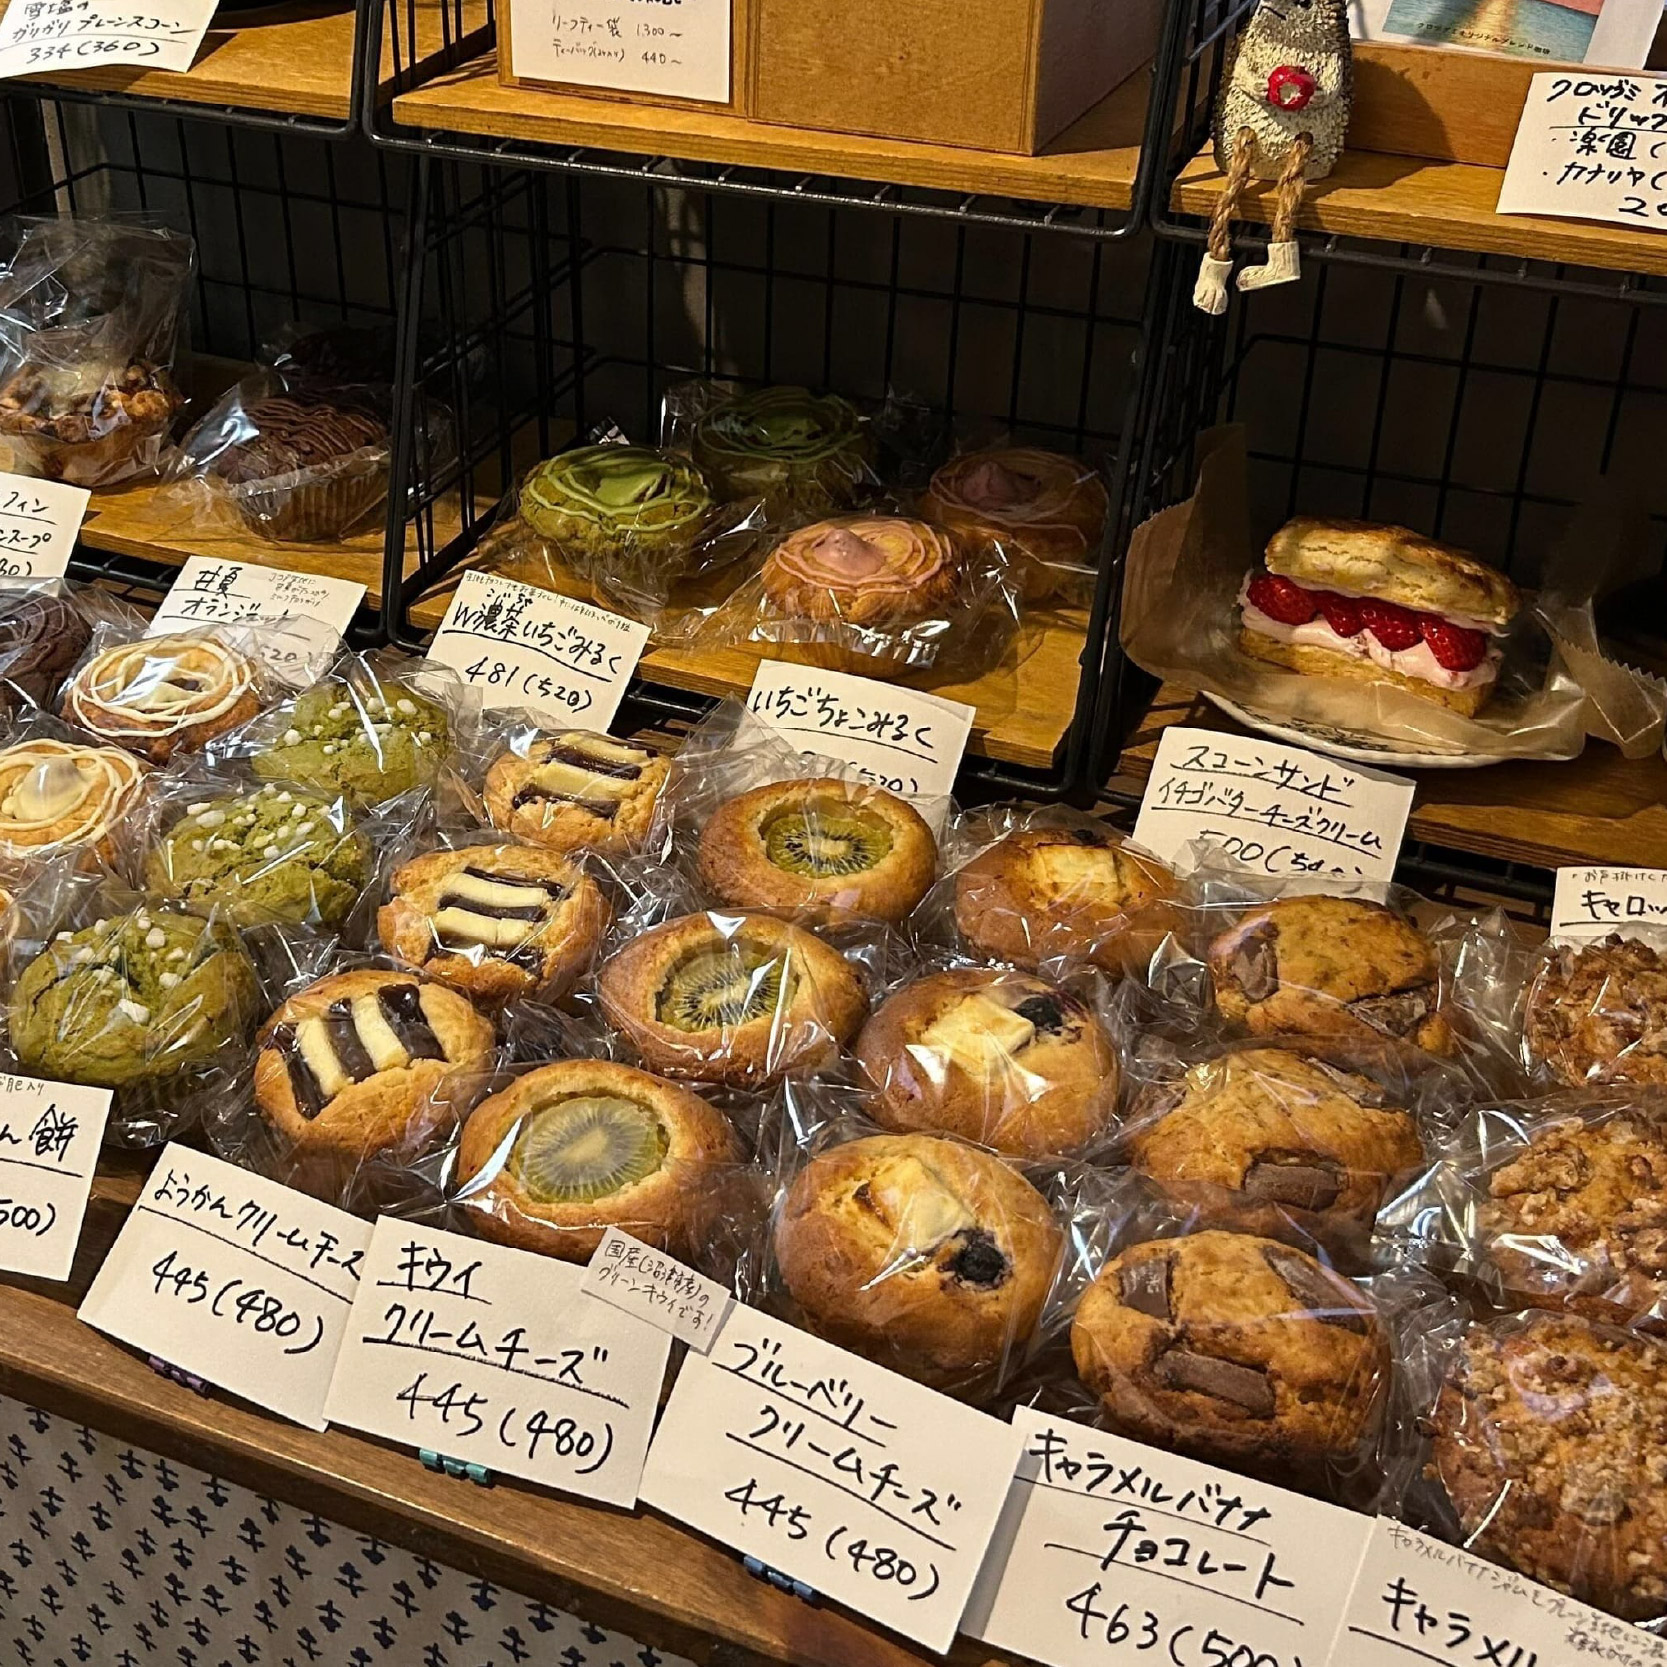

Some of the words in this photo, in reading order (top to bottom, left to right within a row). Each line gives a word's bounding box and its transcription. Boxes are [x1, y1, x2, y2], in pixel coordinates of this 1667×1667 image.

[753, 686, 934, 749] いちごちょこみるく
[1159, 777, 1382, 850] イチゴバターチーズクリーム
[397, 1241, 483, 1299] キウイ
[385, 1304, 608, 1384] クリームチーズ
[732, 1337, 897, 1430] ブルーベリー
[749, 1404, 962, 1525] クリームチーズ
[1029, 1428, 1271, 1531] キャラメルバナナ
[1100, 1510, 1294, 1599] チョコレート
